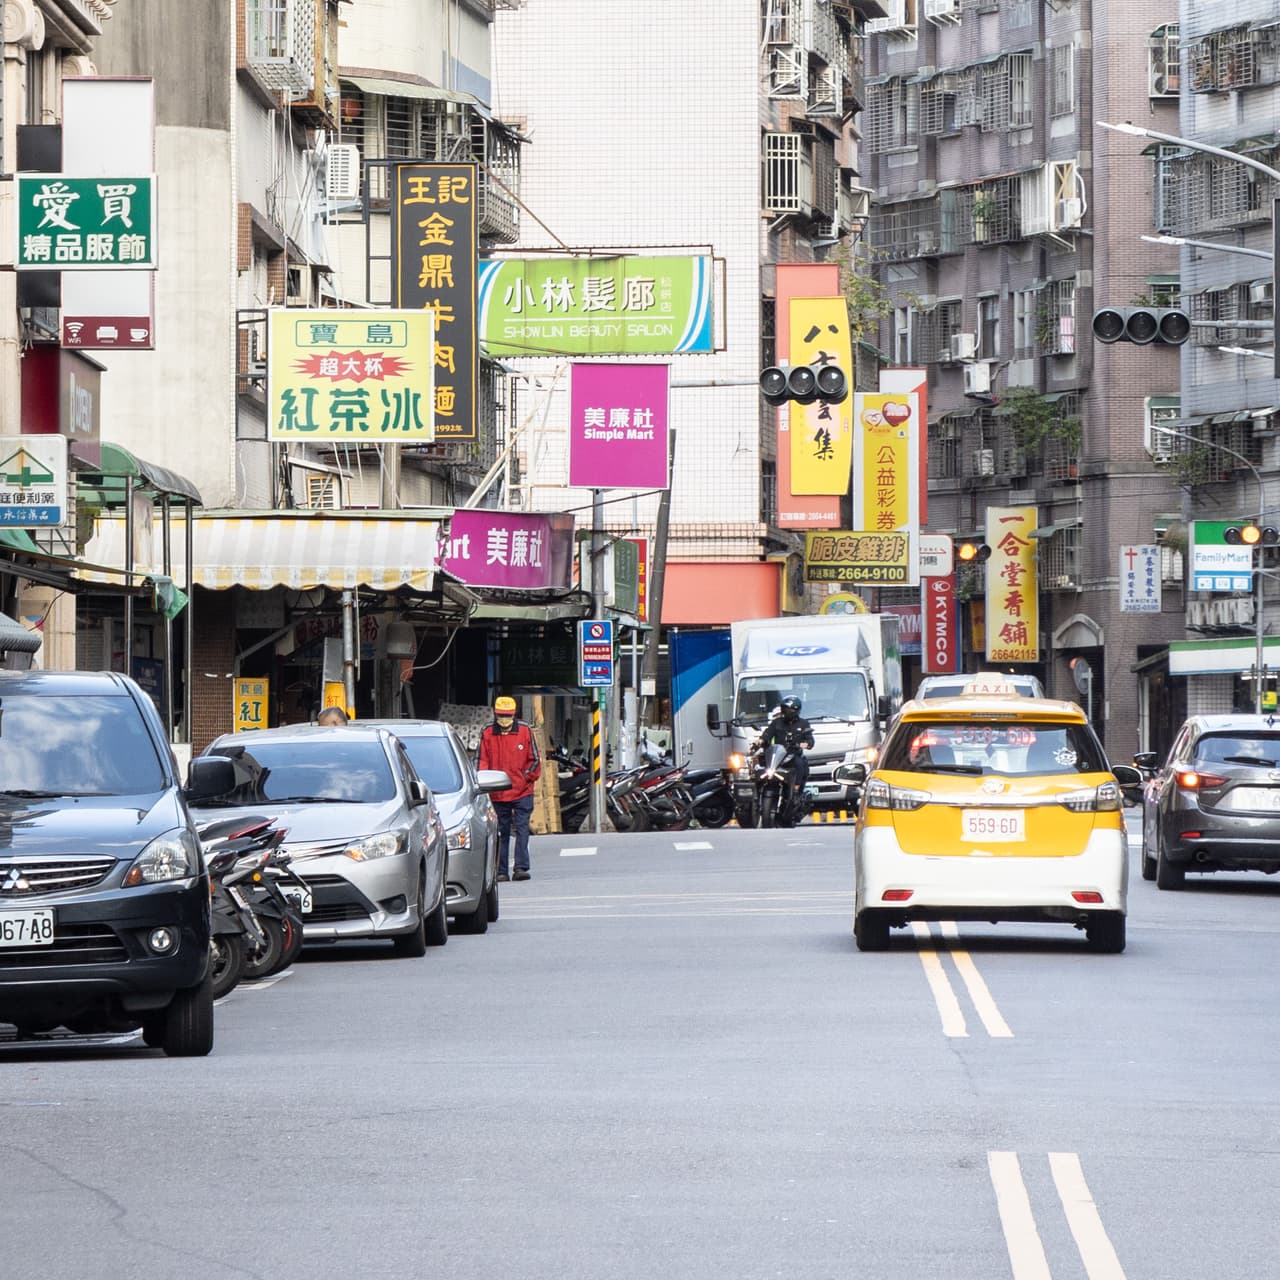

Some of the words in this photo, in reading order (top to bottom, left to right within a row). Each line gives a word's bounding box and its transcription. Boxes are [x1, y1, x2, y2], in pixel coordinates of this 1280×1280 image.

[404, 176, 469, 205] 王記
[33, 182, 137, 231] 愛買
[23, 234, 146, 261] 精品服飾
[504, 275, 656, 314] 小林髮廊
[310, 323, 393, 344] 寶島
[571, 324, 621, 337] BEAUTY
[628, 323, 673, 337] SALON
[320, 357, 384, 376] 超大杯
[279, 387, 424, 432] 紅茶冰
[584, 408, 654, 429] 美廉社
[584, 429, 624, 442] Simple
[627, 429, 654, 440] Mart
[877, 445, 896, 530] 公益彩券
[487, 528, 542, 568] 美廉社
[810, 535, 905, 562] 脆皮雞排
[1196, 552, 1249, 564] FamilyMart
[838, 567, 904, 581] 2664-9100
[935, 596, 948, 666] KYMCO
[992, 648, 1037, 661] 26642115
[972, 684, 1010, 693] TAXI
